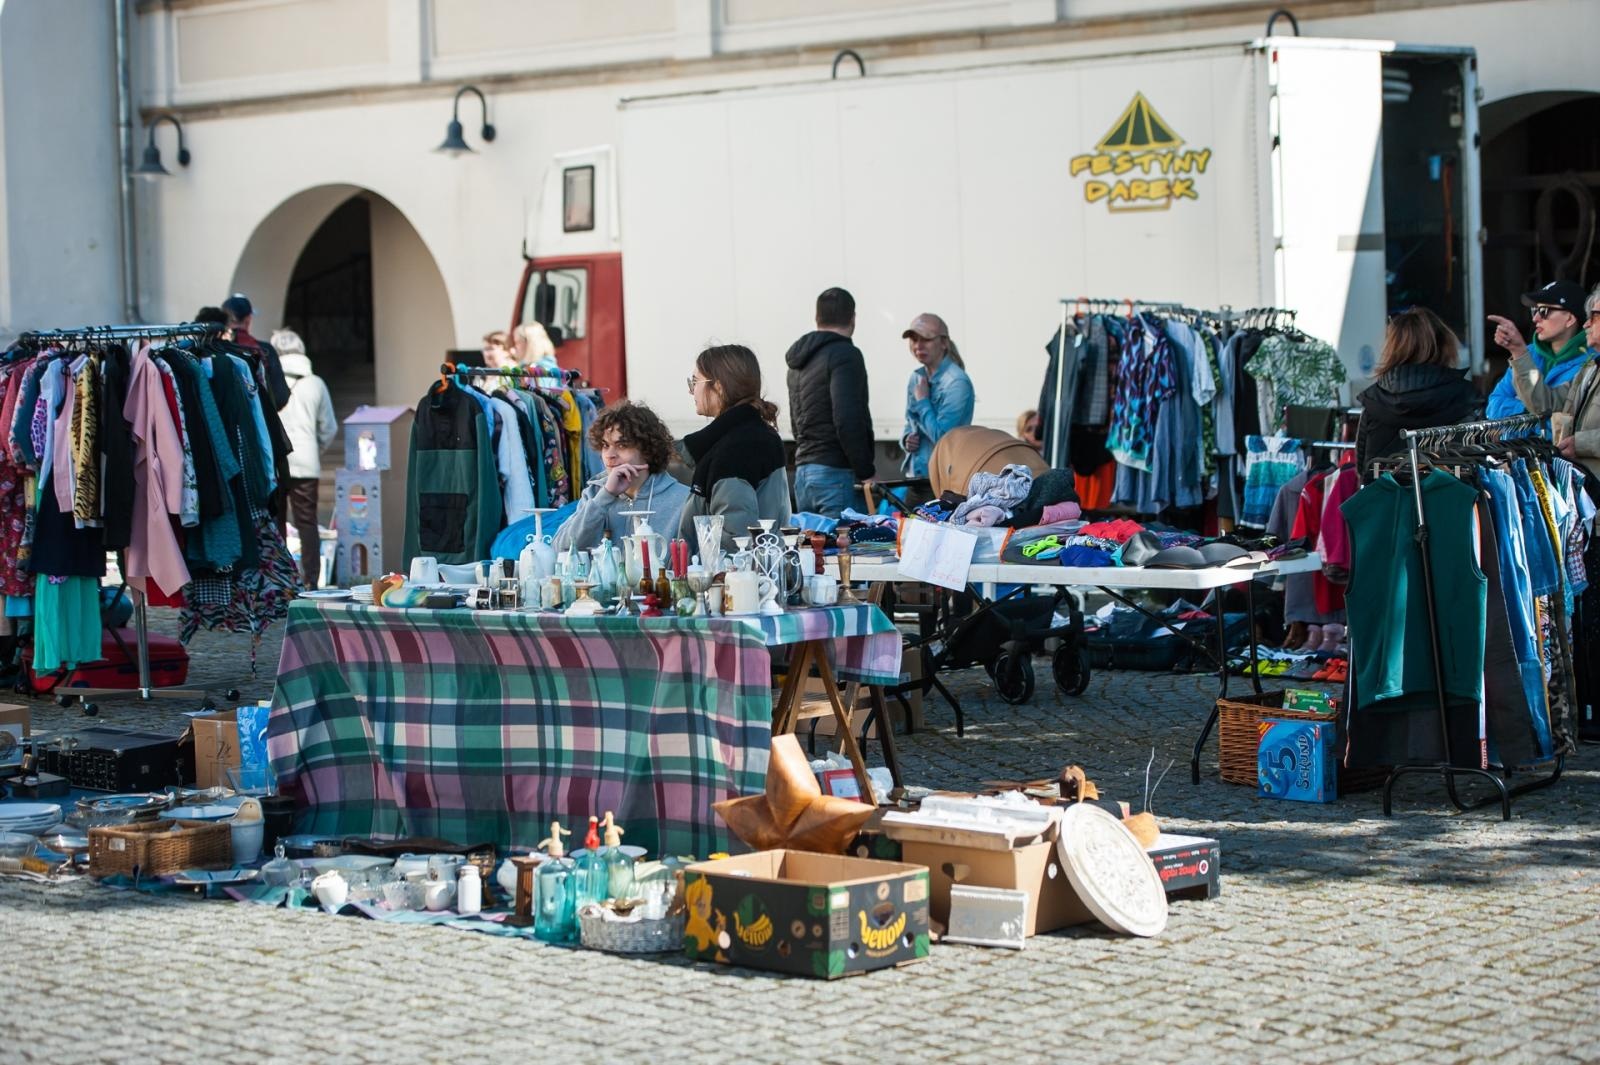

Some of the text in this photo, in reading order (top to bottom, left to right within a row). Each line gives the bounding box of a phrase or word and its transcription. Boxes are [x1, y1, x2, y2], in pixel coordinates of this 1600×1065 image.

[1070, 148, 1211, 177] FESTYNY
[1085, 178, 1198, 203] DAREK
[1267, 746, 1297, 772] 5
